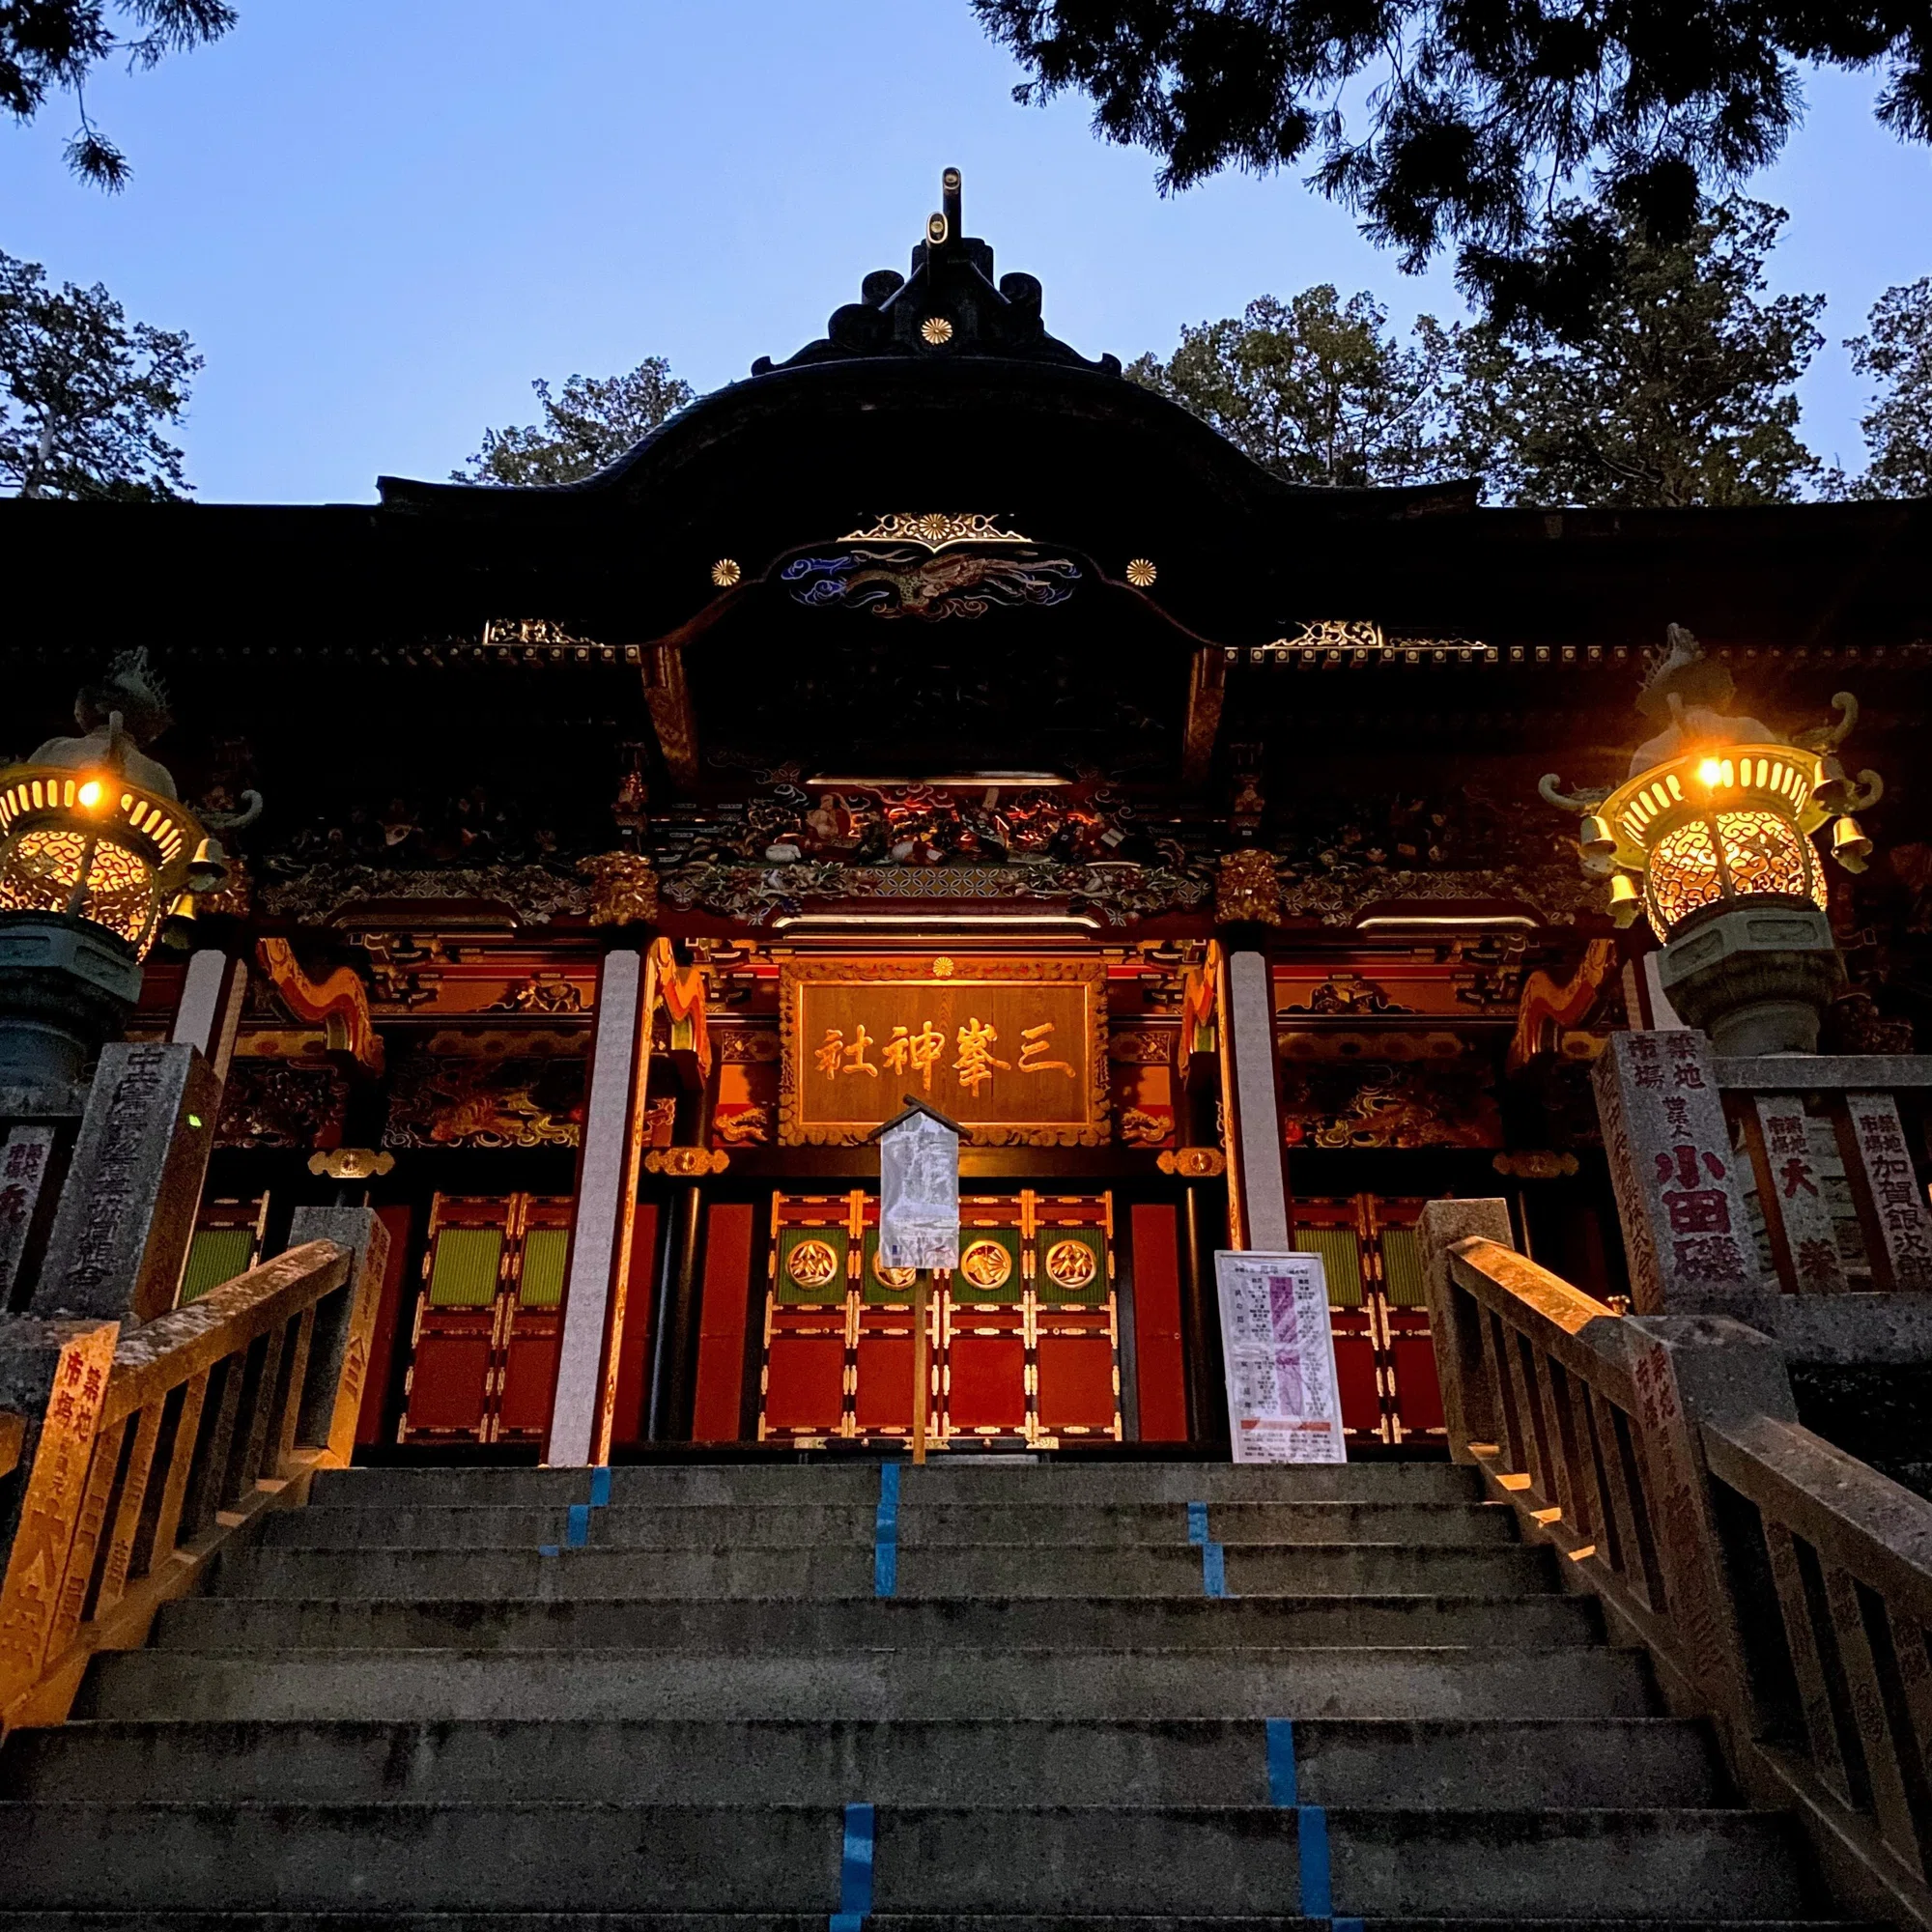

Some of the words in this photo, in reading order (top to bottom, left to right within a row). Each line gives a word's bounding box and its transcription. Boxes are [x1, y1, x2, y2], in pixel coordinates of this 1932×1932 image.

[814, 1016, 1076, 1097] 三峯神社
[1628, 1036, 1665, 1089] 市場
[1665, 1035, 1705, 1089] 築地
